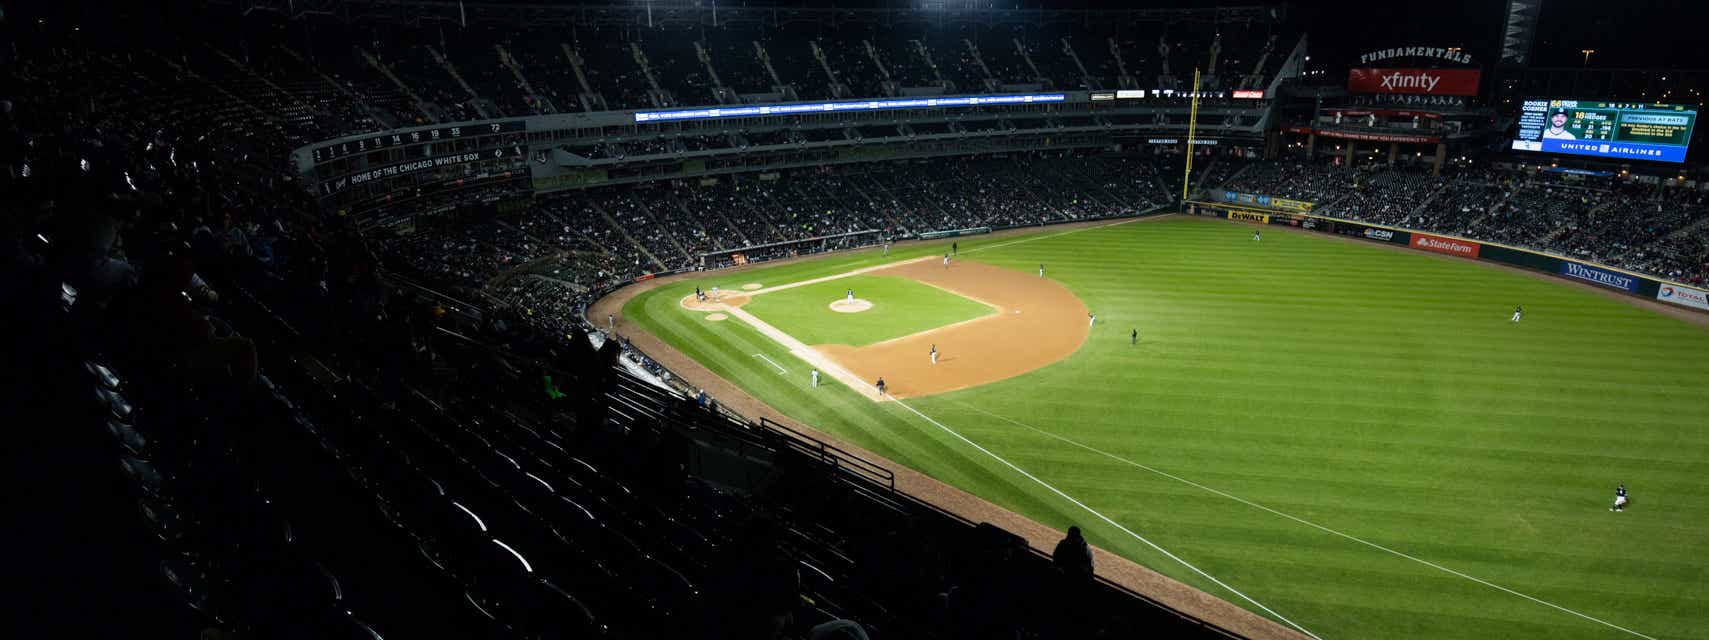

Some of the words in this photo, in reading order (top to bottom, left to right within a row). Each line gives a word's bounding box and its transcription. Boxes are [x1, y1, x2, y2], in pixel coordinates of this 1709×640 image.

[1360, 47, 1472, 64] FUNDAMENTALS
[1380, 71, 1441, 92] xfinity
[1561, 143, 1598, 151] UNITED
[1611, 146, 1662, 156] AIRLINES
[351, 172, 373, 185] HOME
[373, 169, 382, 179] OF
[383, 166, 398, 177] THE
[400, 159, 433, 173] CHICAGO
[434, 154, 462, 167] WHITE
[463, 152, 480, 163] SOX
[1375, 229, 1394, 239] CSN
[1567, 262, 1632, 288] WINTRUST
[1677, 290, 1705, 302] TOTAL
